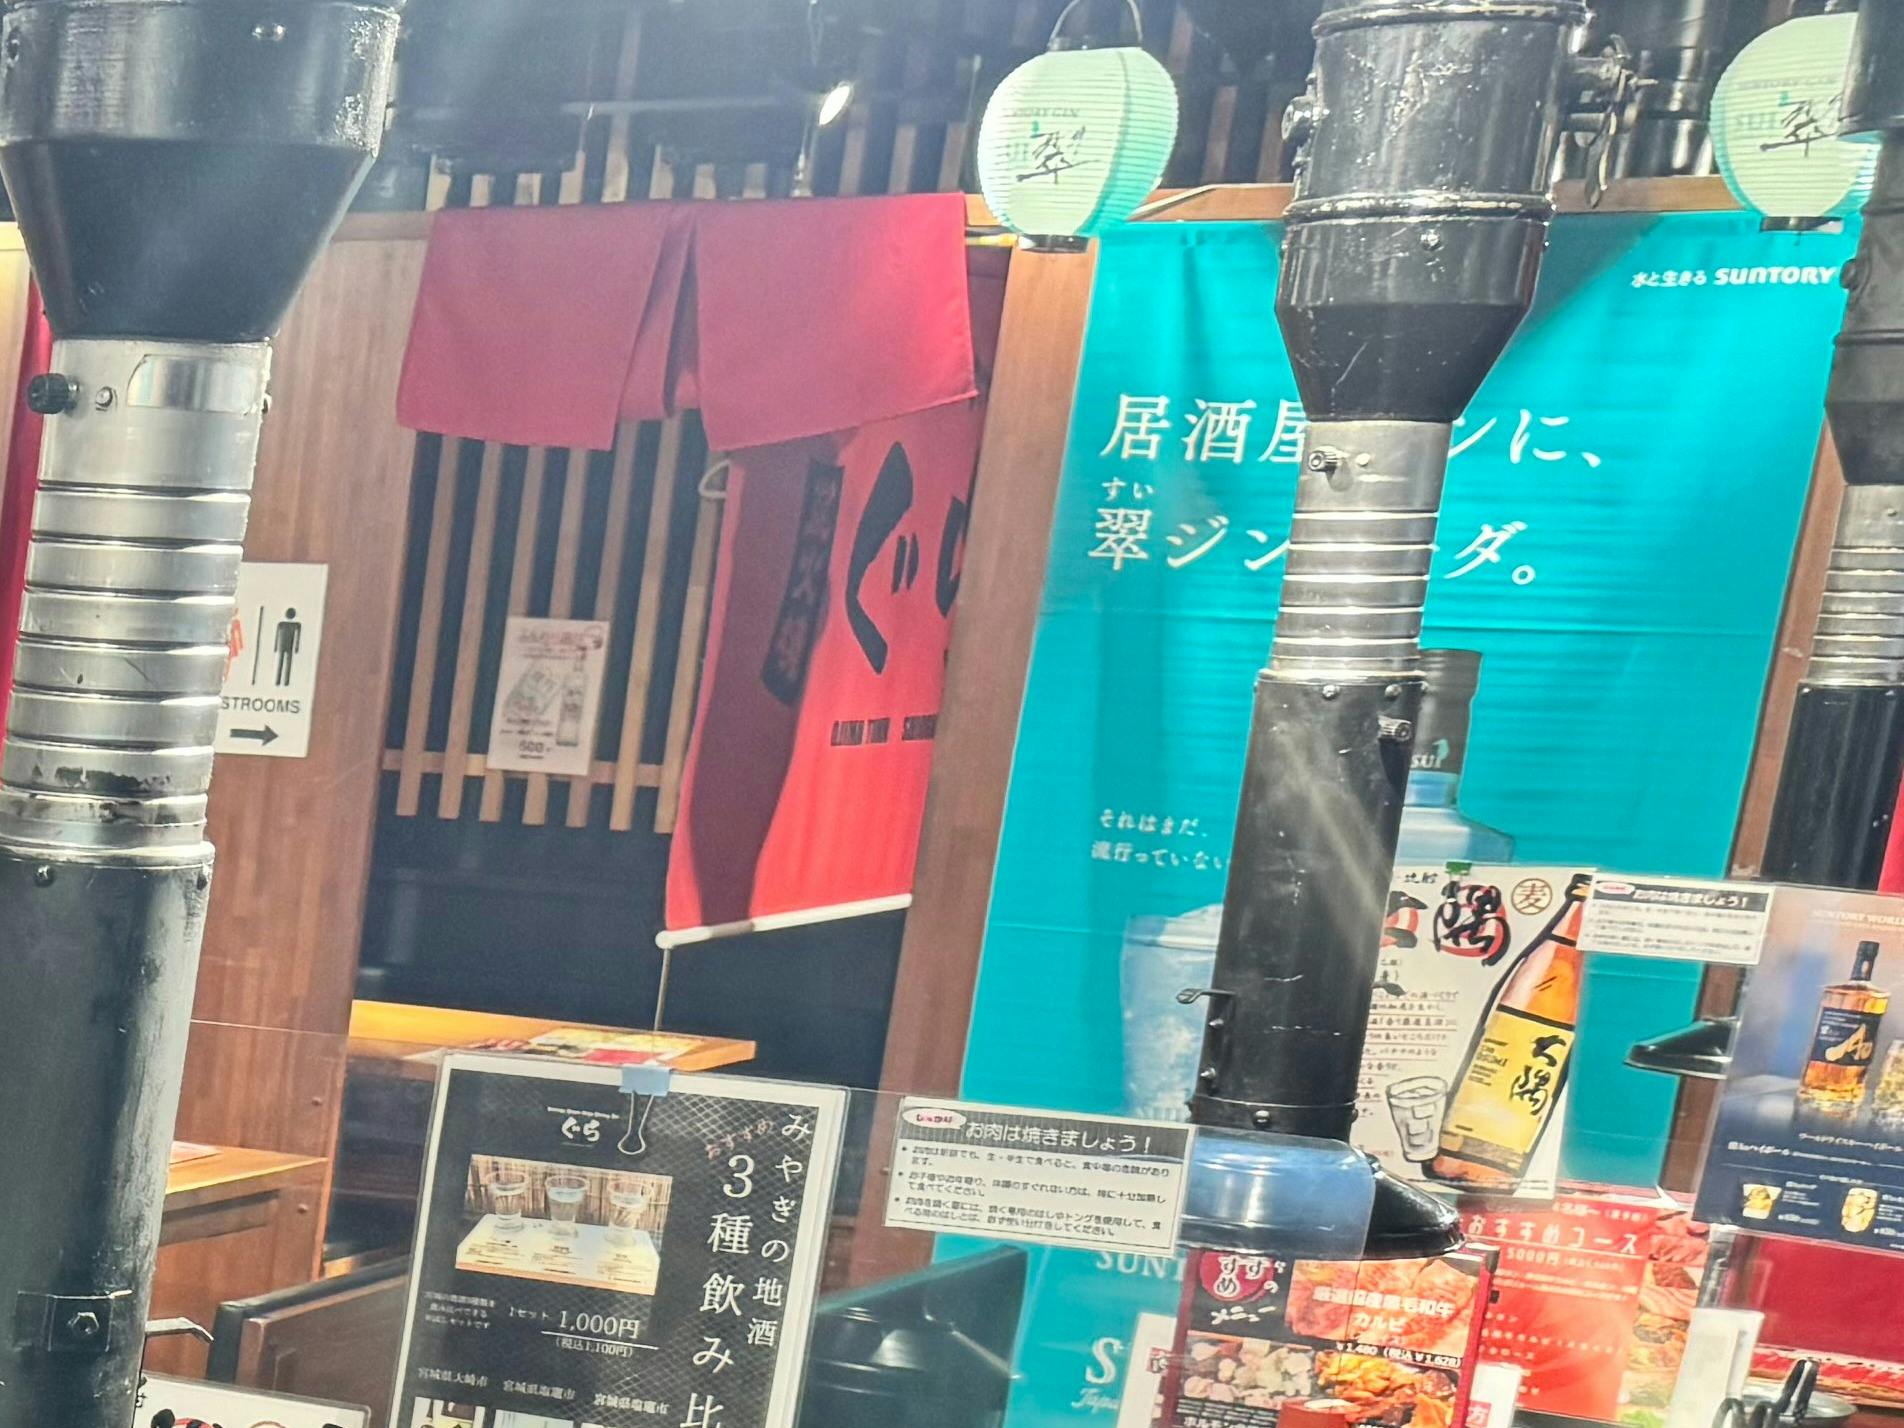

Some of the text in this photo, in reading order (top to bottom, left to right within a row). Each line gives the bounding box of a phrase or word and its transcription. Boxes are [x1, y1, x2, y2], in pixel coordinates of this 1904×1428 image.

[1631, 266, 1839, 289] 水と生きる SUNTORY
[1099, 393, 1602, 469] 居酒屋に、
[1102, 475, 1156, 501] すい
[1088, 507, 1538, 586] 翠ジンダ。
[221, 696, 301, 714] STROOMS
[1101, 808, 1209, 838] それはまだ、
[1514, 880, 1549, 914] 麦
[561, 1115, 601, 1143] ぐら
[965, 1120, 1152, 1155] お肉は焼きましょう！
[746, 1112, 813, 1349] みやぎの地酒
[1467, 1213, 1640, 1256] おすすめコース
[558, 1309, 641, 1340] 1,000円
